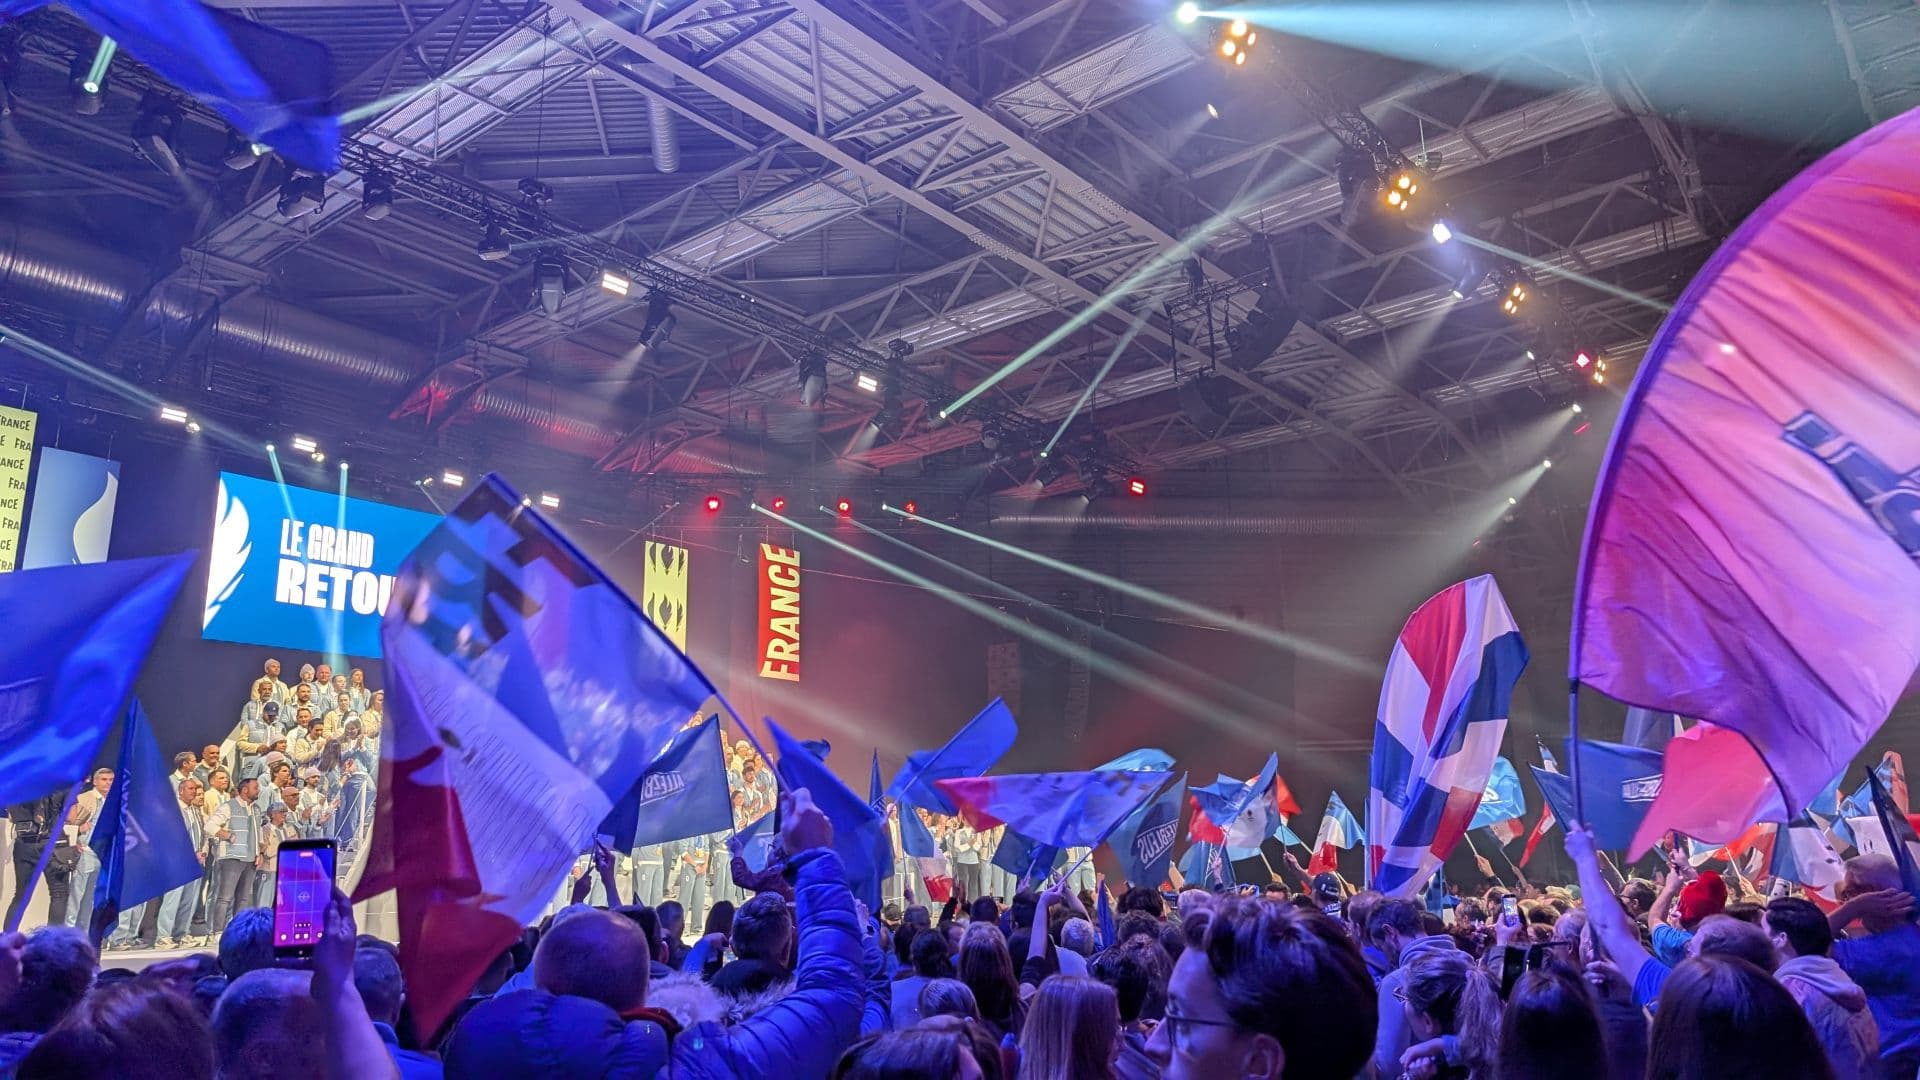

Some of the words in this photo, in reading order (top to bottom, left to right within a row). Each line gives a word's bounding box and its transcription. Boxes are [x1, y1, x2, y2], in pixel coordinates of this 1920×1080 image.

[0, 414, 31, 431] RANCE
[280, 518, 304, 557] LE
[307, 523, 375, 569] GRAND
[760, 543, 801, 682] FRANCE
